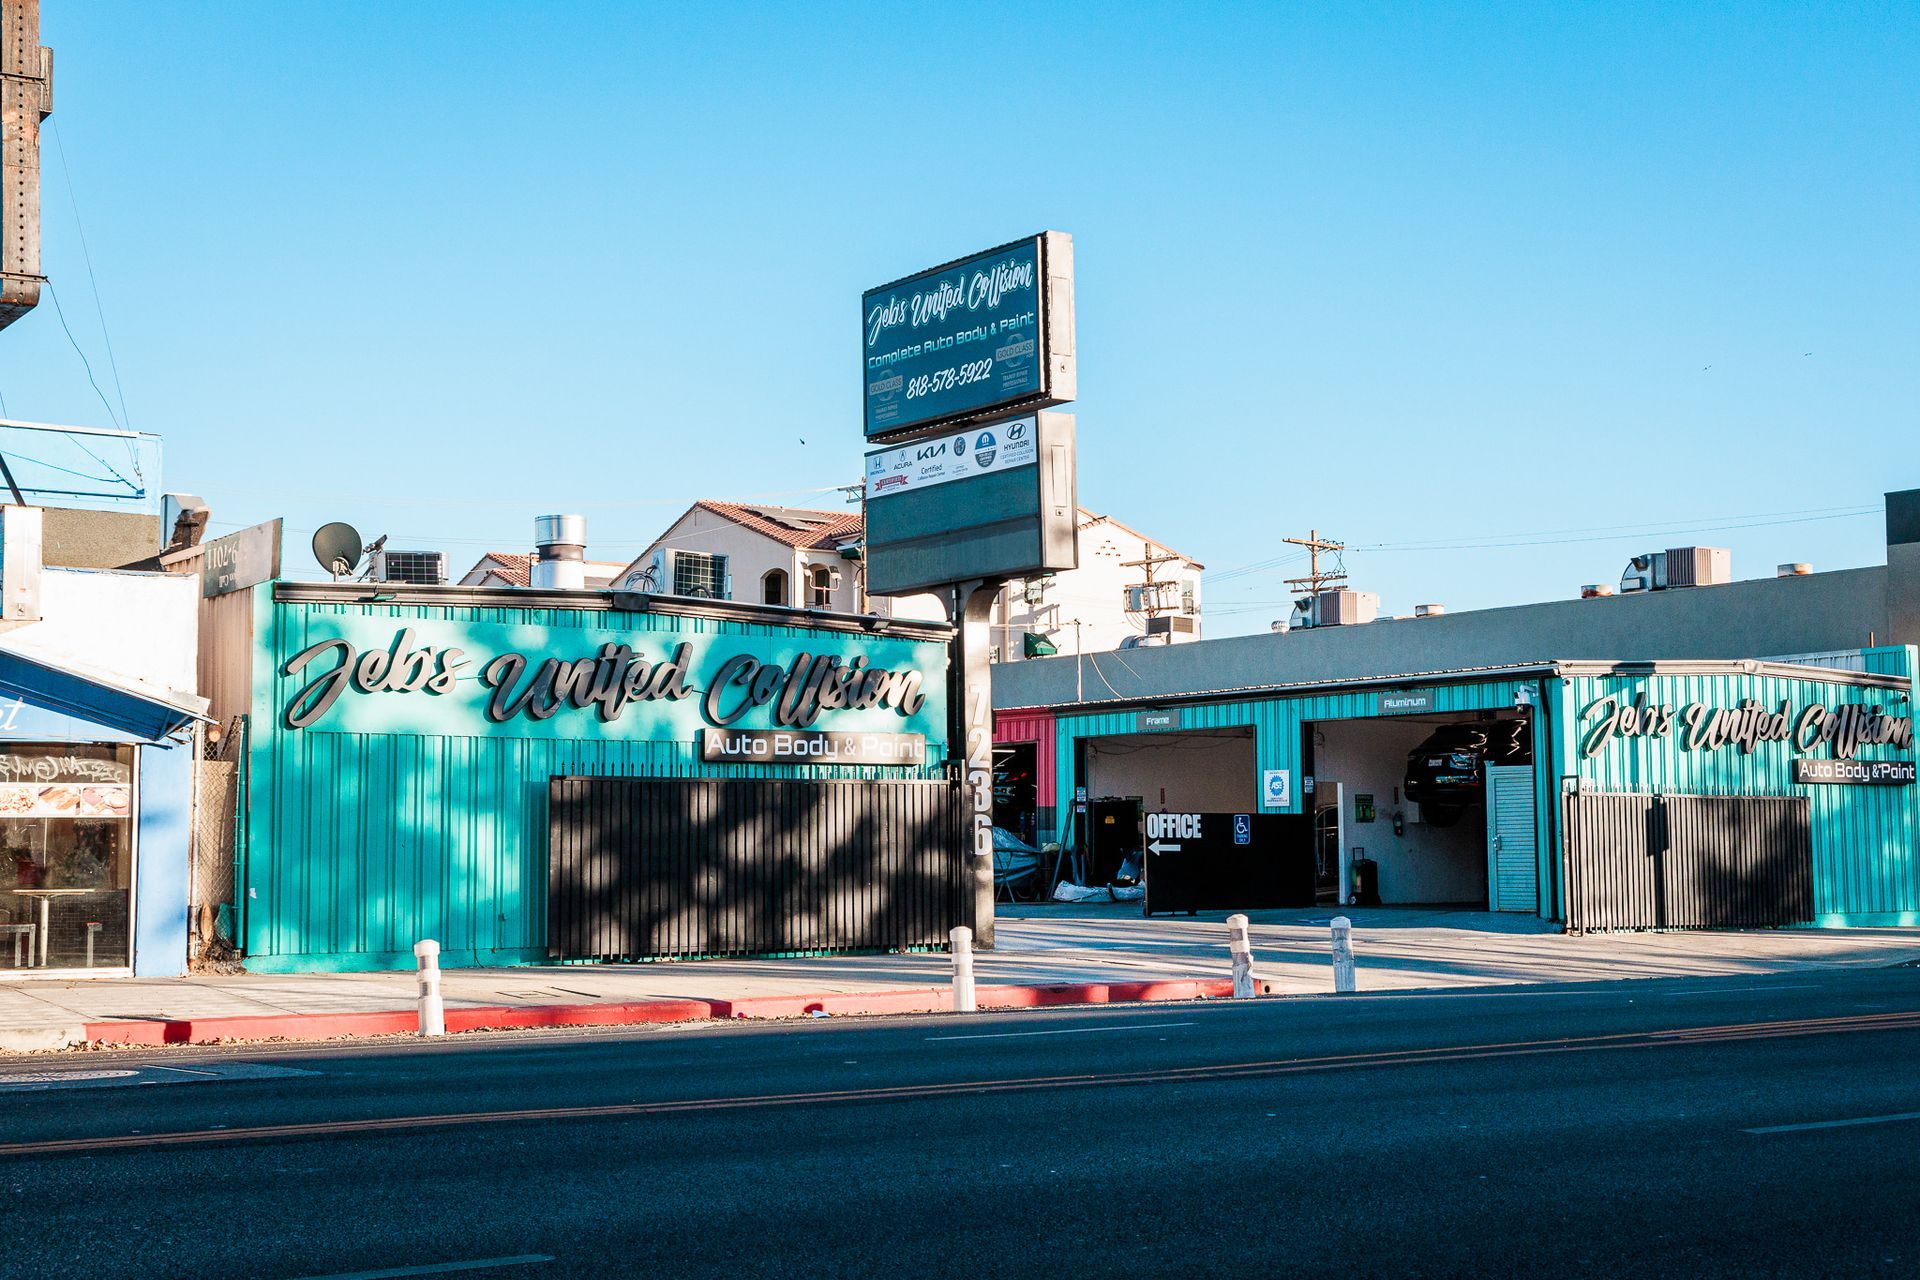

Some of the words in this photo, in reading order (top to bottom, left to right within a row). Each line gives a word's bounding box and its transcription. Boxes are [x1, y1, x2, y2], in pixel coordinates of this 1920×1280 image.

[868, 297, 908, 346] Jeb's
[911, 276, 965, 327] United
[968, 260, 1033, 310] Collision
[868, 344, 921, 369] Complete
[924, 335, 954, 354] Auto
[956, 325, 987, 345] Body
[990, 322, 997, 335] &
[1000, 311, 1034, 333] Paint
[997, 347, 1014, 359] GOLD
[1014, 341, 1033, 354] CLASS
[906, 357, 993, 400] 818-578-5922
[917, 443, 946, 461] KIA
[1003, 439, 1030, 452] HYUNDAI
[893, 461, 913, 471] ACURA
[920, 463, 943, 475] Certified
[285, 626, 472, 729] Jeb's
[485, 641, 694, 722] United
[706, 652, 926, 727] Collision
[1384, 697, 1426, 709] Aluminum
[1146, 716, 1170, 726] Frame
[1583, 692, 1678, 759] Jeb's
[1684, 698, 1792, 754] United
[1797, 704, 1914, 759] Collision
[706, 733, 767, 755] Auto
[774, 734, 839, 760] Body
[844, 736, 856, 756] &
[862, 737, 925, 758] Paint
[968, 684, 993, 856] 7236
[1800, 762, 1832, 778] Auto
[1835, 762, 1869, 781] Body
[1872, 764, 1880, 778] &
[1881, 763, 1915, 779] Paint
[1147, 813, 1202, 839] OFFICE
